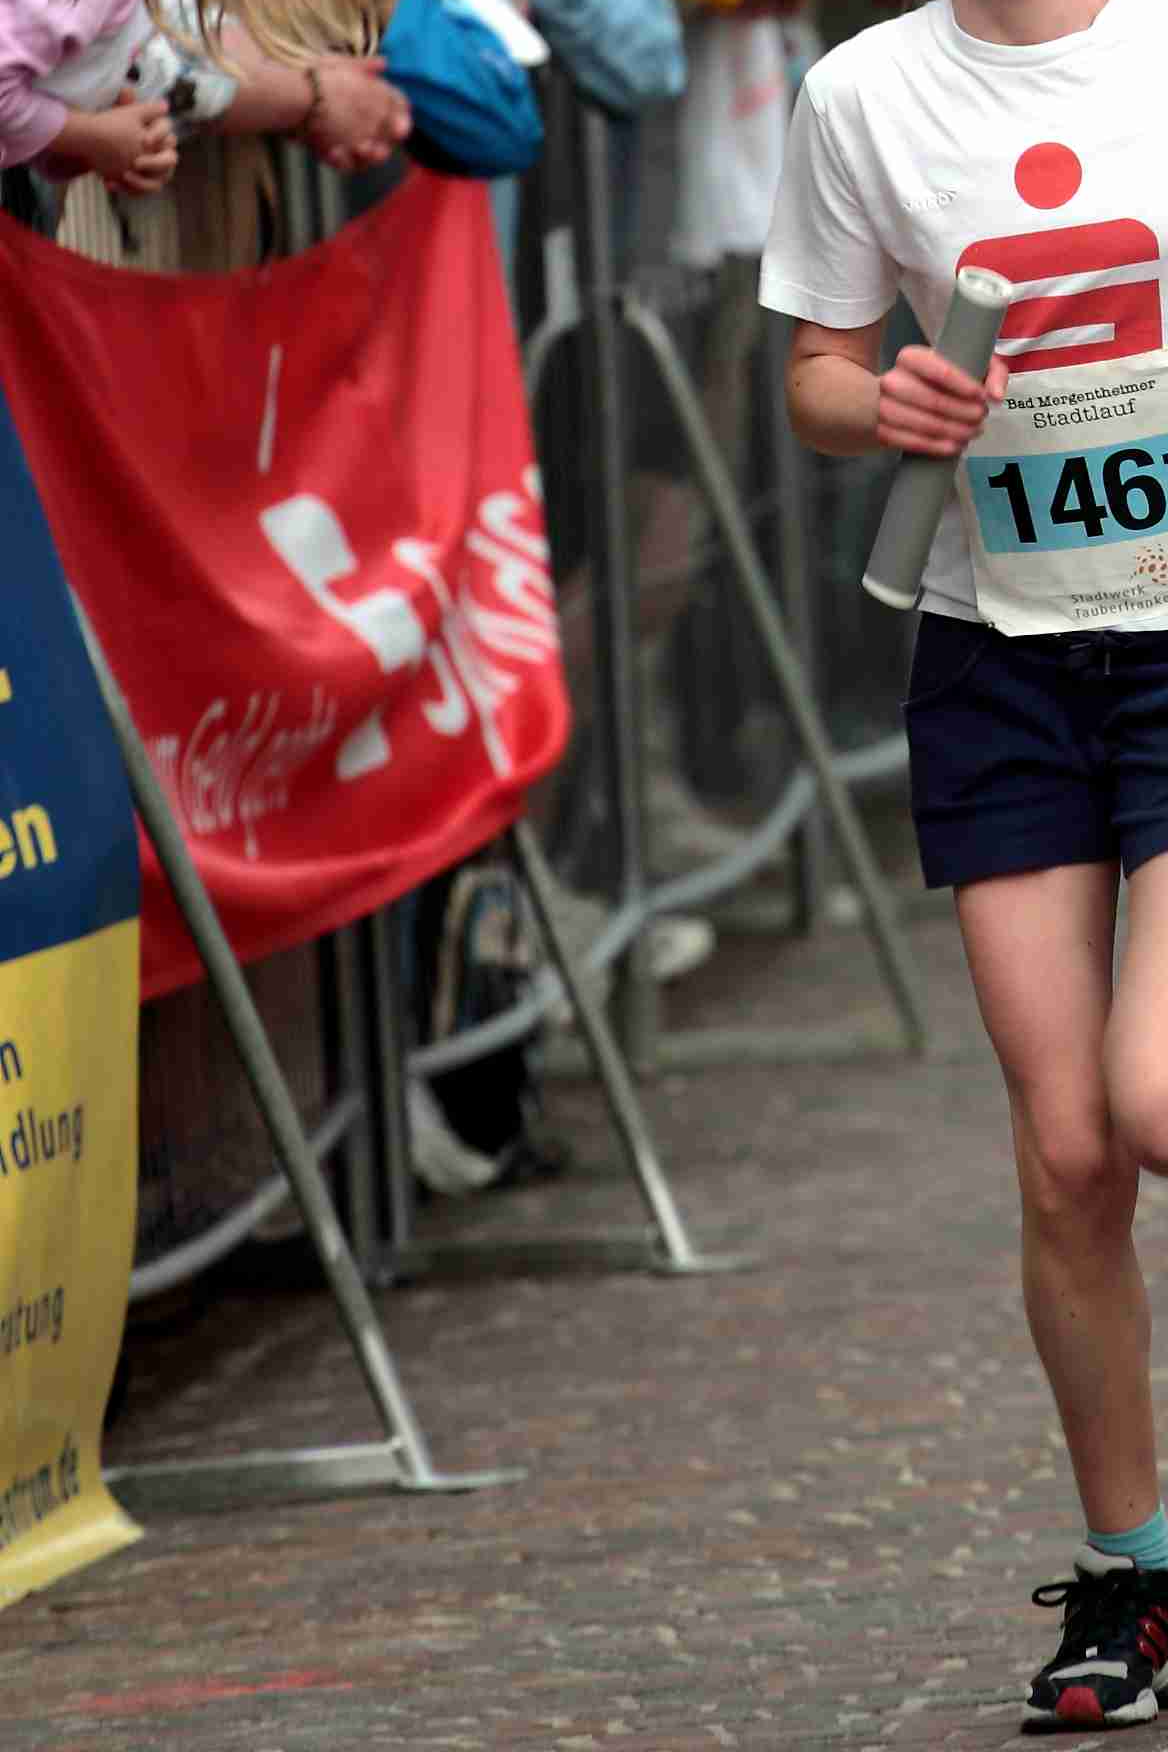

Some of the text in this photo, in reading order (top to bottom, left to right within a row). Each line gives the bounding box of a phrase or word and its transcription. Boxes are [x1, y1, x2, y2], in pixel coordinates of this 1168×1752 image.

[1007, 379, 1156, 410] Bad Mergentheimer
[1033, 398, 1137, 429] Stadtlauf
[1071, 584, 1145, 604] Stadtwerk
